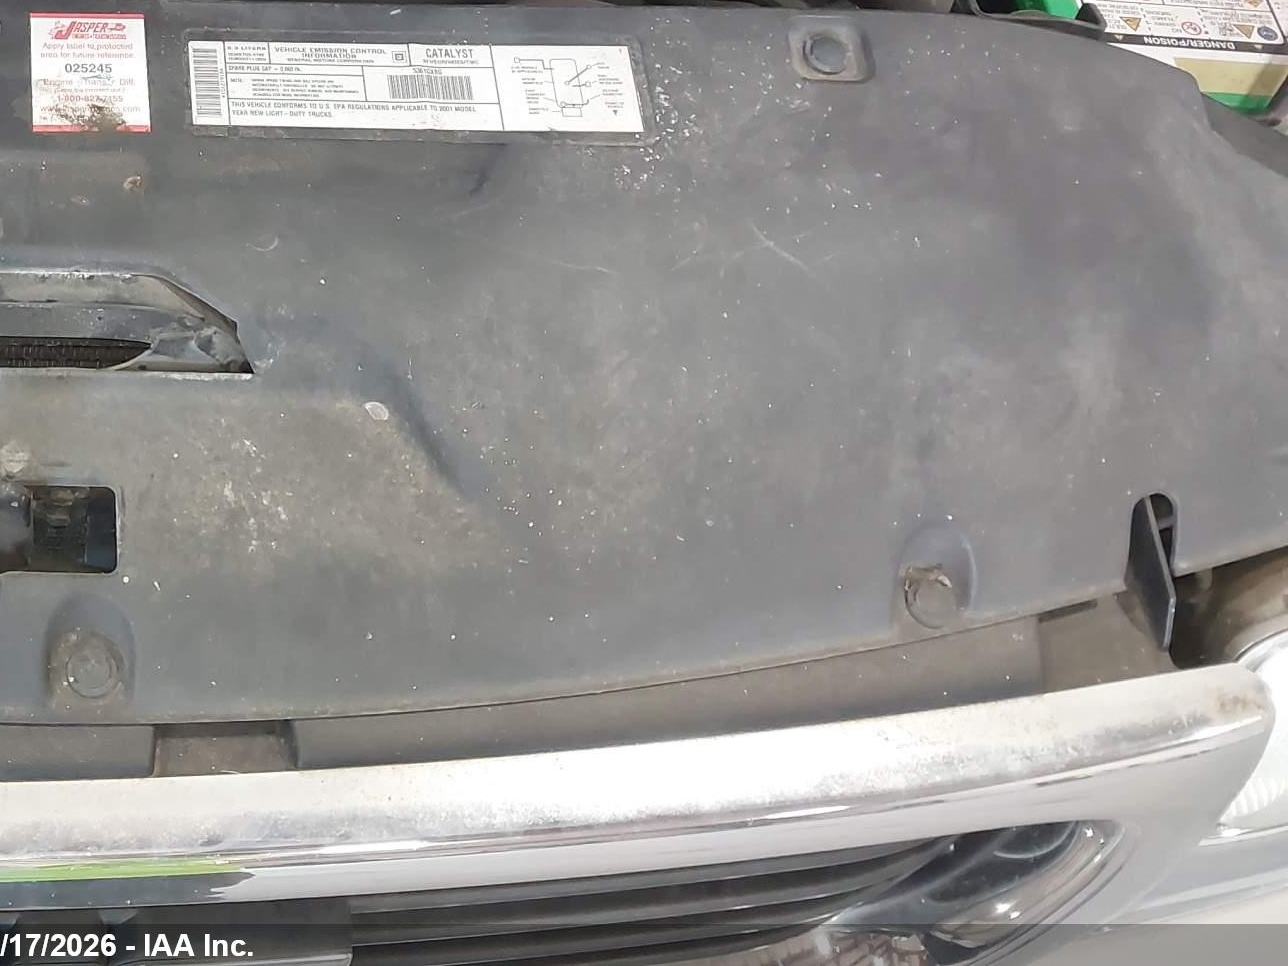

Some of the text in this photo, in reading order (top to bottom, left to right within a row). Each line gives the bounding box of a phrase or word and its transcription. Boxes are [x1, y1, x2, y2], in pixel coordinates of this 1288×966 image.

[54, 21, 109, 40] JASPER
[42, 42, 64, 51] Apply
[1142, 35, 1236, 50] DANGER/POISON
[350, 47, 387, 55] CONTROL
[425, 48, 474, 59] CATALYST
[65, 63, 113, 73] 025245
[247, 101, 272, 109] VEHICLE
[274, 102, 307, 110] CONFORMS
[333, 103, 345, 111] EPA
[347, 103, 390, 111] REGULATIONS
[392, 104, 428, 112] APPLICABLE
[455, 105, 476, 113] MODEL
